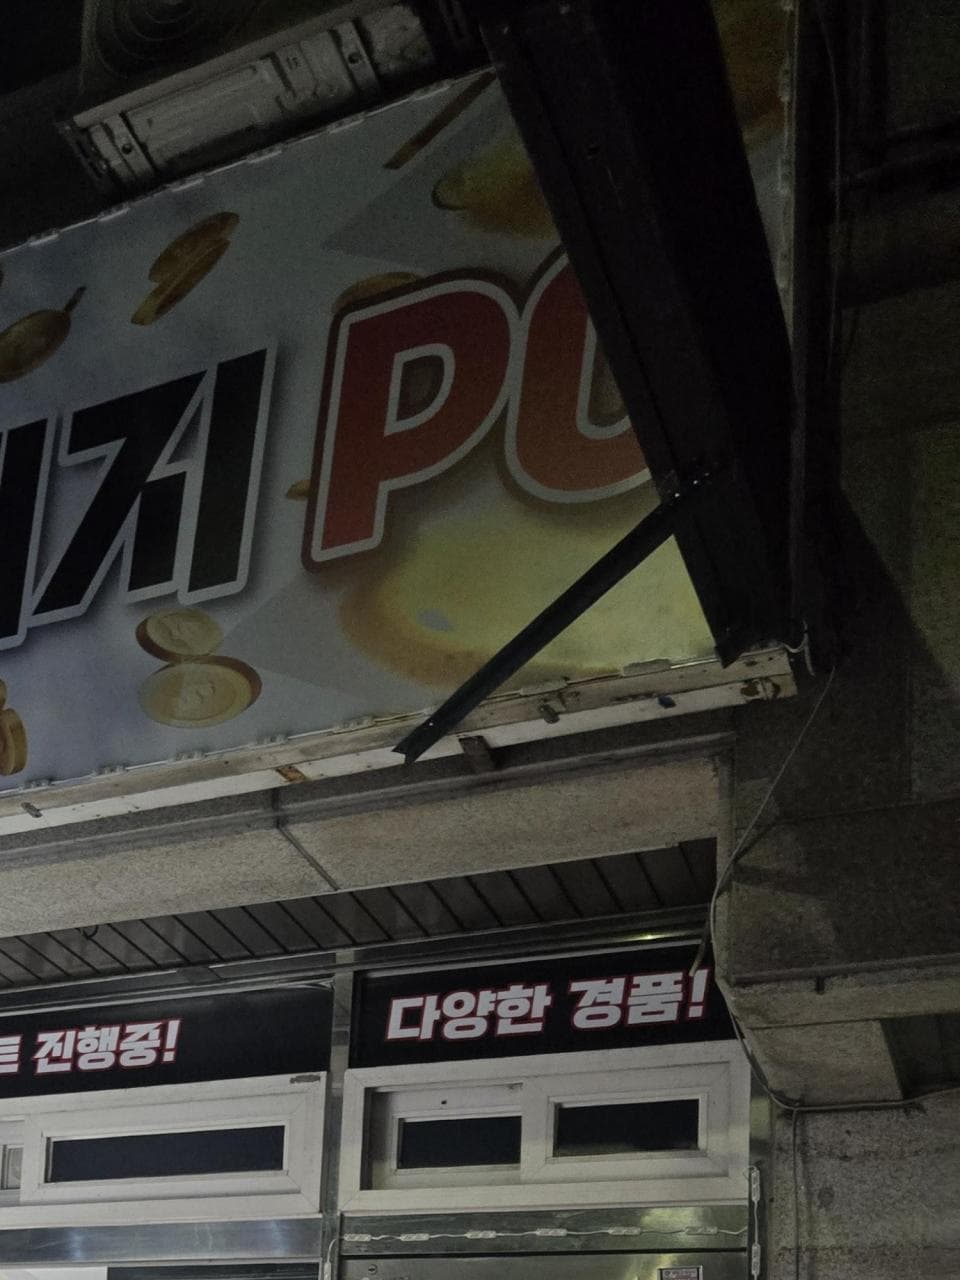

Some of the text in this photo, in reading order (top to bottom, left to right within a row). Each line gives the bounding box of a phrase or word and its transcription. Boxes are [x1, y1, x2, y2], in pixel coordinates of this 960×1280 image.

[386, 968, 710, 1040] 다양한 경품!
[34, 1020, 181, 1074] 진행중!
